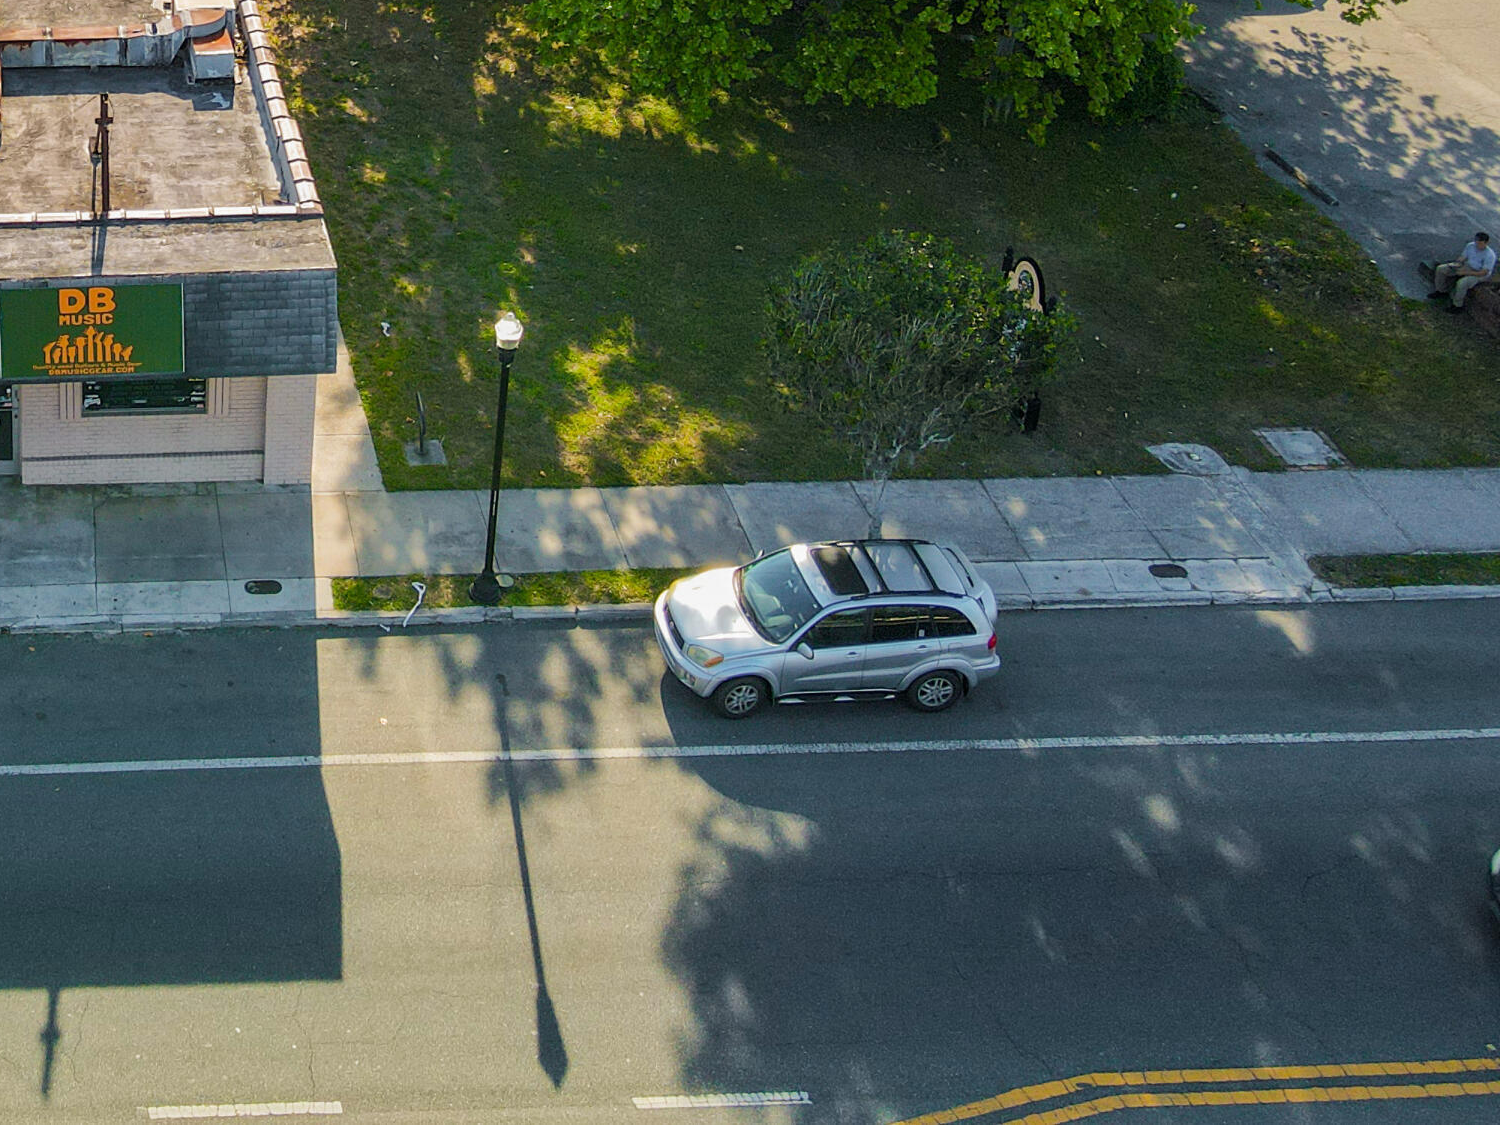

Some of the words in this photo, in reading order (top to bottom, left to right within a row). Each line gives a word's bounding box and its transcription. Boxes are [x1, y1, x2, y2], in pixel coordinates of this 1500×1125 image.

[58, 286, 116, 314] DB
[58, 313, 114, 326] MUSIC
[48, 366, 135, 376] DBMUSICGEAR.COM
